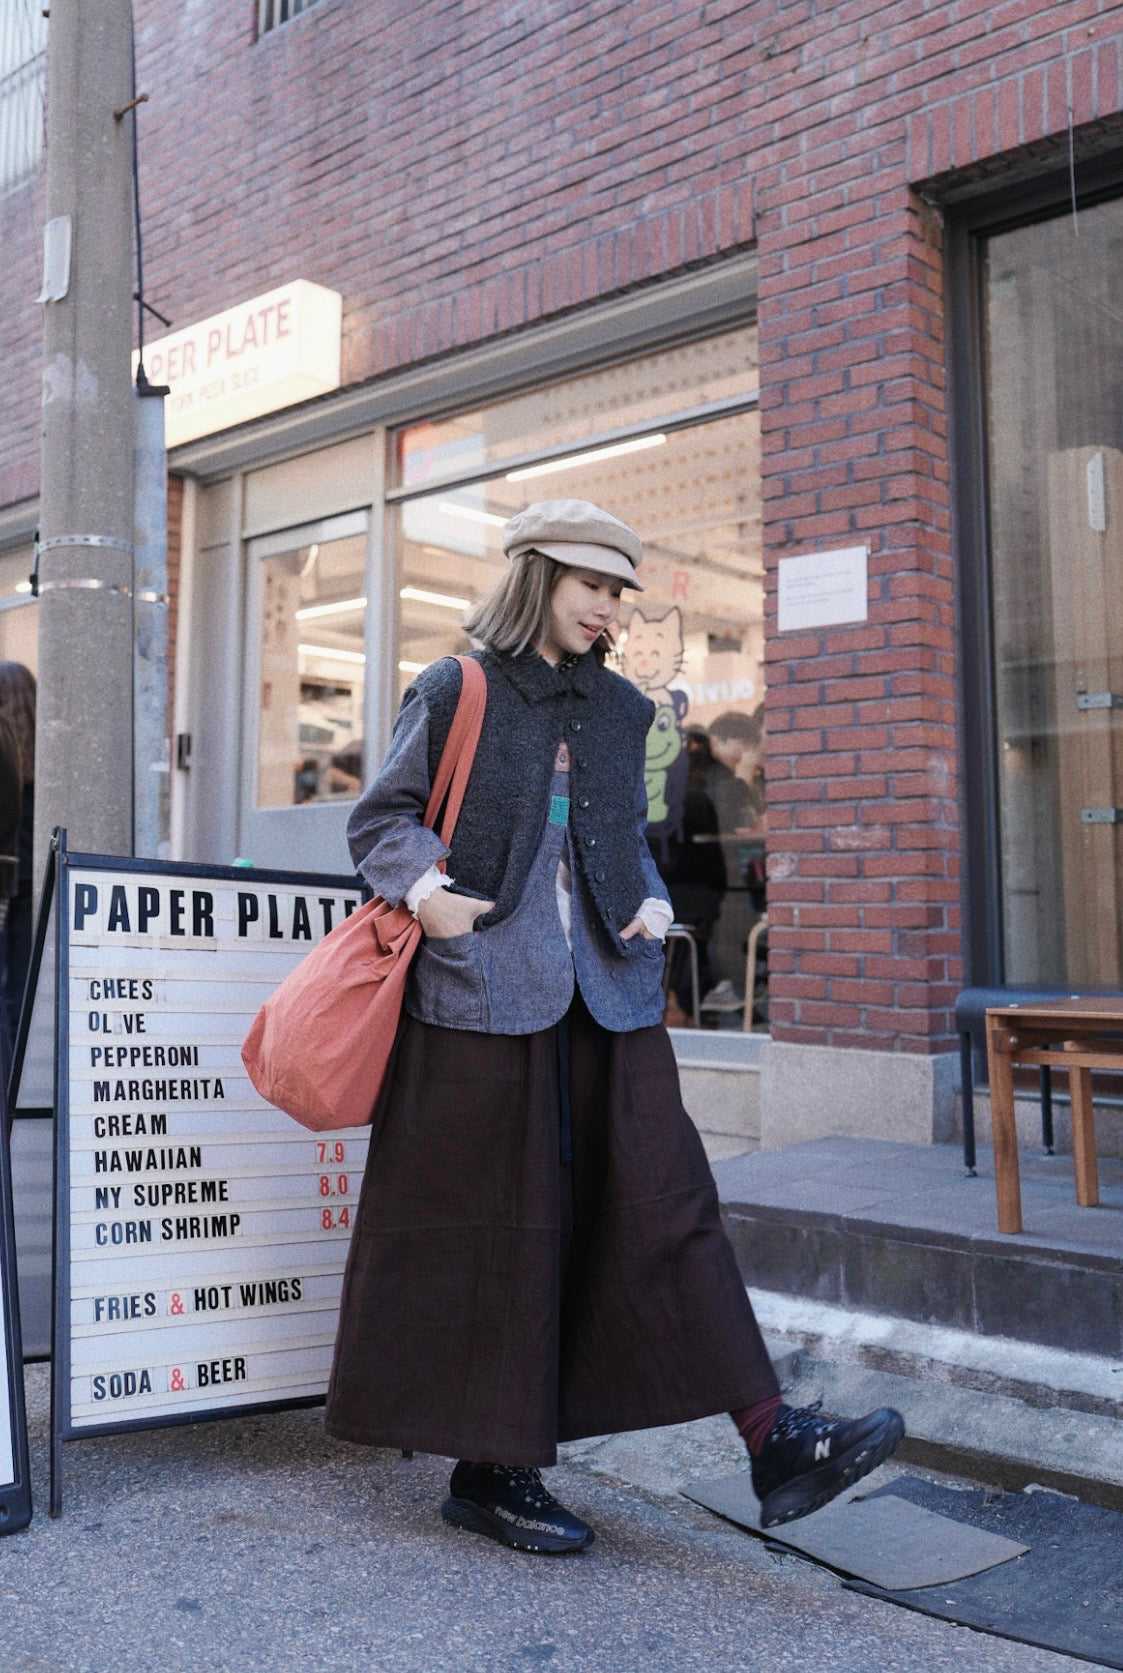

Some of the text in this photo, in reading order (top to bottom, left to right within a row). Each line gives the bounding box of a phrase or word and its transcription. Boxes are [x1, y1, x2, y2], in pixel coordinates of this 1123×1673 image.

[148, 297, 291, 386] PER PLATE
[73, 883, 357, 940] PAPER PLAT
[90, 979, 153, 1001] CHEES
[90, 1046, 199, 1068] PEPPERONI
[93, 1078, 225, 1102] MARGHERITA
[94, 1113, 167, 1138] CREAM
[94, 1143, 344, 1173] HAWAIIAN 7.9
[95, 1174, 348, 1209] NY SUPREME 8.0
[95, 1207, 349, 1246] CORN SHRIMP 8.4
[94, 1278, 302, 1322] FRIES & HOT WINGS
[93, 1357, 246, 1401] SODA & BEER
[815, 1437, 831, 1461] N
[494, 1505, 518, 1523] new
